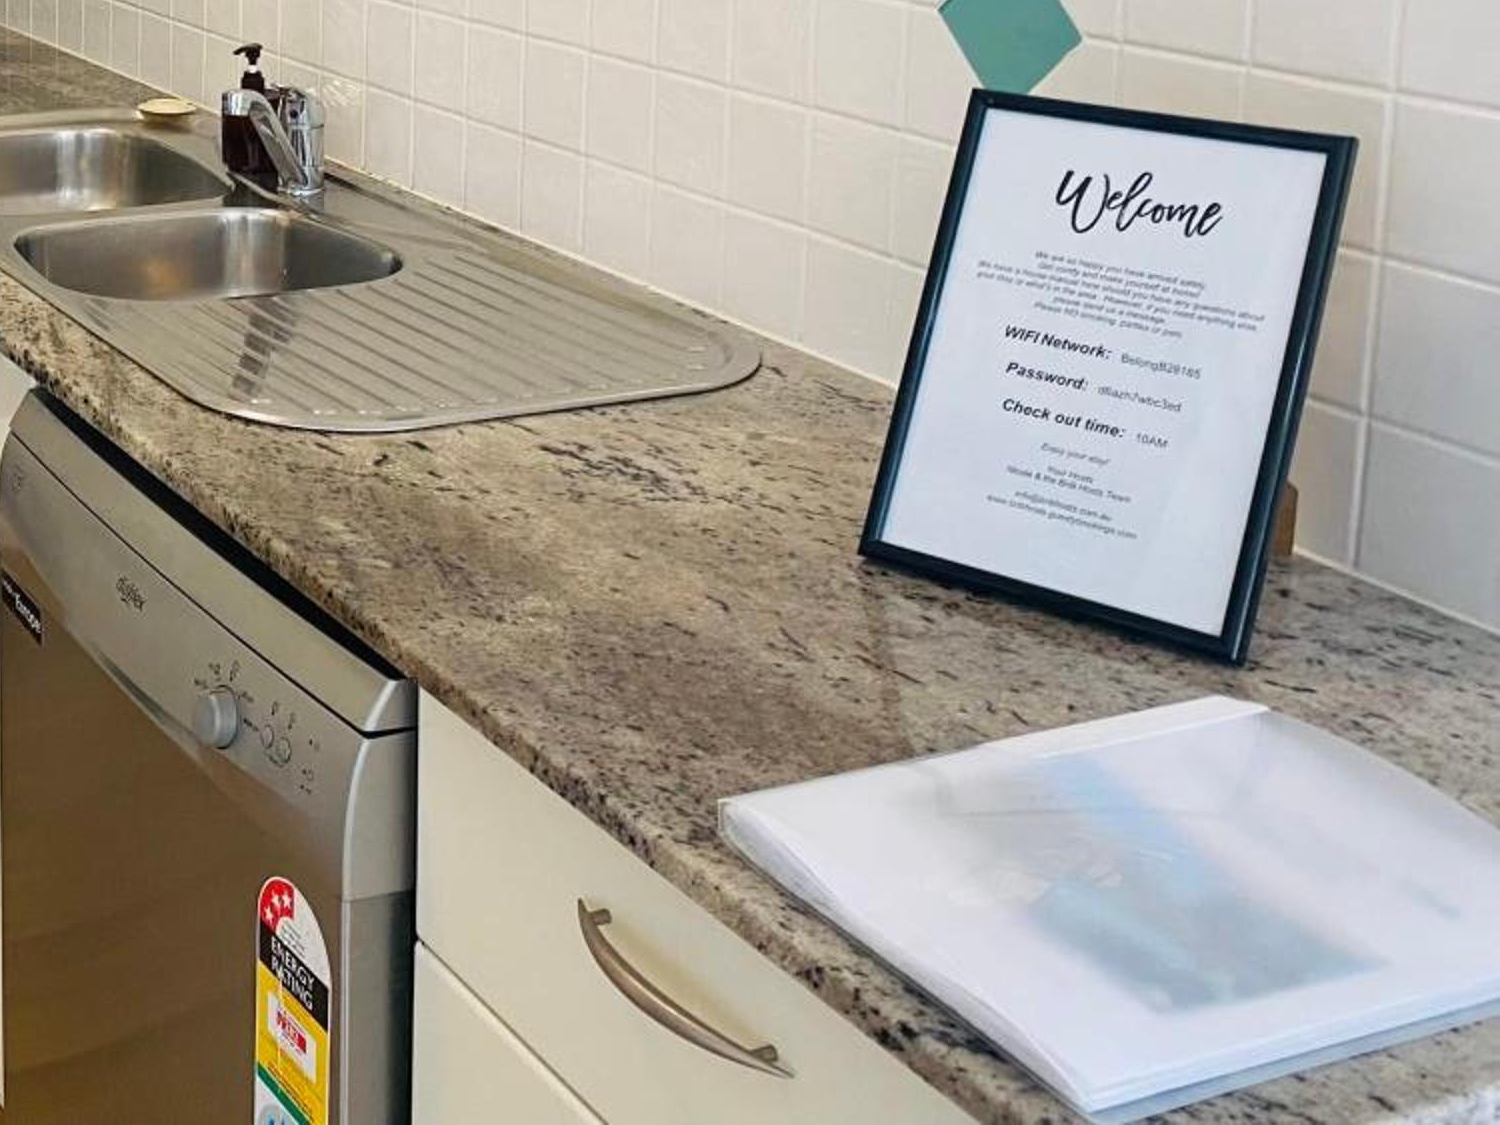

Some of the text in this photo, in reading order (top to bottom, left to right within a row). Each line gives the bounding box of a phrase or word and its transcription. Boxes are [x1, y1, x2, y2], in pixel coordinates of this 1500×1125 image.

[1056, 170, 1222, 237] Welcome
[1006, 325, 1040, 343] WIFI
[1041, 333, 1112, 359] Network:
[1006, 362, 1088, 390] Password:
[1003, 399, 1168, 448] Check out time: 10AM
[271, 936, 316, 991] ENERGY
[271, 956, 313, 1011] RATING
